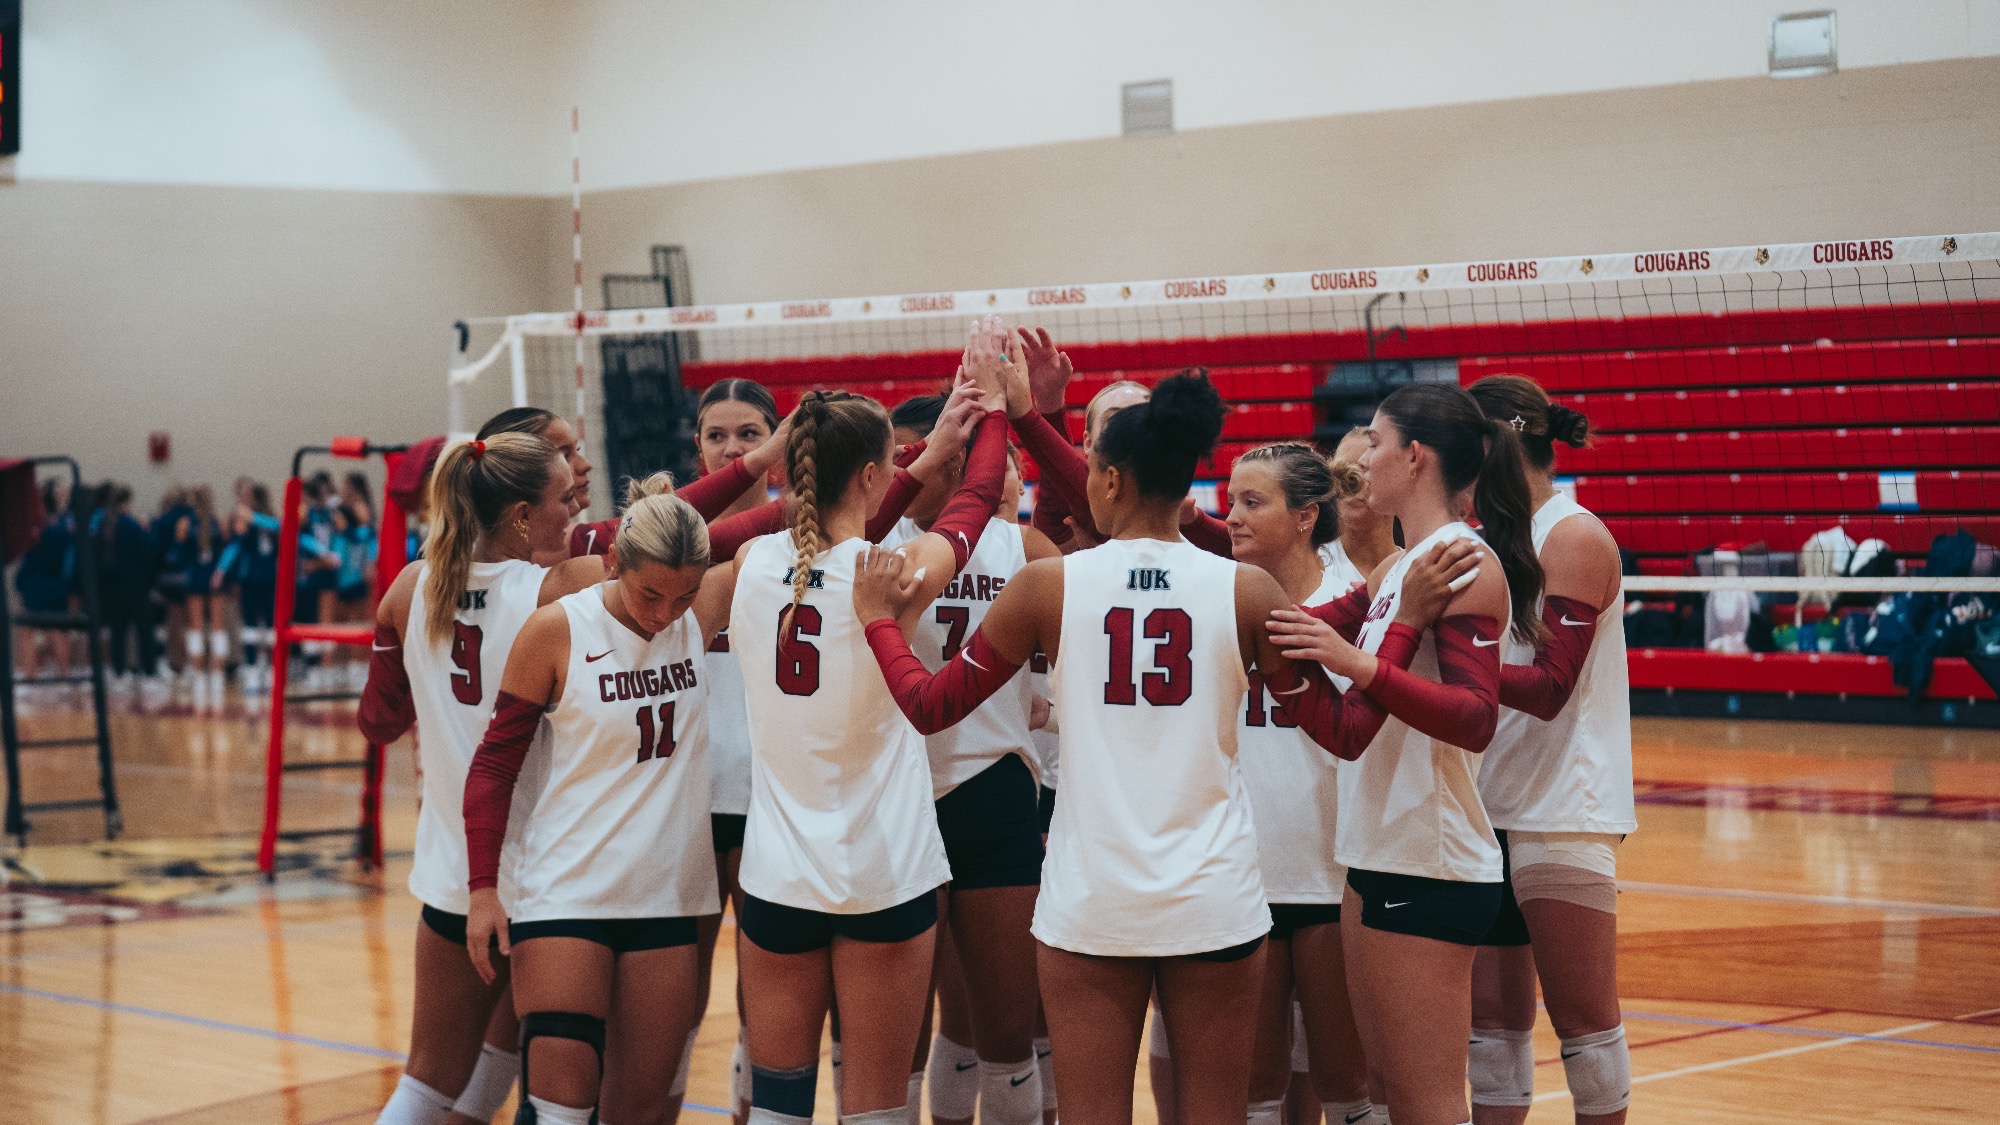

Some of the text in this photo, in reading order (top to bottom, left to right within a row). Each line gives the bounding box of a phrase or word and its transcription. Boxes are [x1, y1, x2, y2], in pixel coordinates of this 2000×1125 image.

[1634, 251, 1711, 273] COUGARS
[1813, 240, 1894, 264] COUGARS
[1311, 270, 1378, 291] COUGARS
[1467, 261, 1538, 283] COUGARS
[1027, 287, 1087, 306] COUGARS
[1165, 279, 1228, 299] COUGARS
[782, 566, 825, 590] IK
[936, 573, 1006, 602] GARS
[1127, 567, 1171, 591] IUK
[936, 605, 970, 661] 7
[775, 602, 822, 697] 6
[1103, 606, 1193, 707] 13
[450, 618, 484, 706] 9
[599, 658, 698, 703] COUGARS
[635, 700, 677, 764] 11
